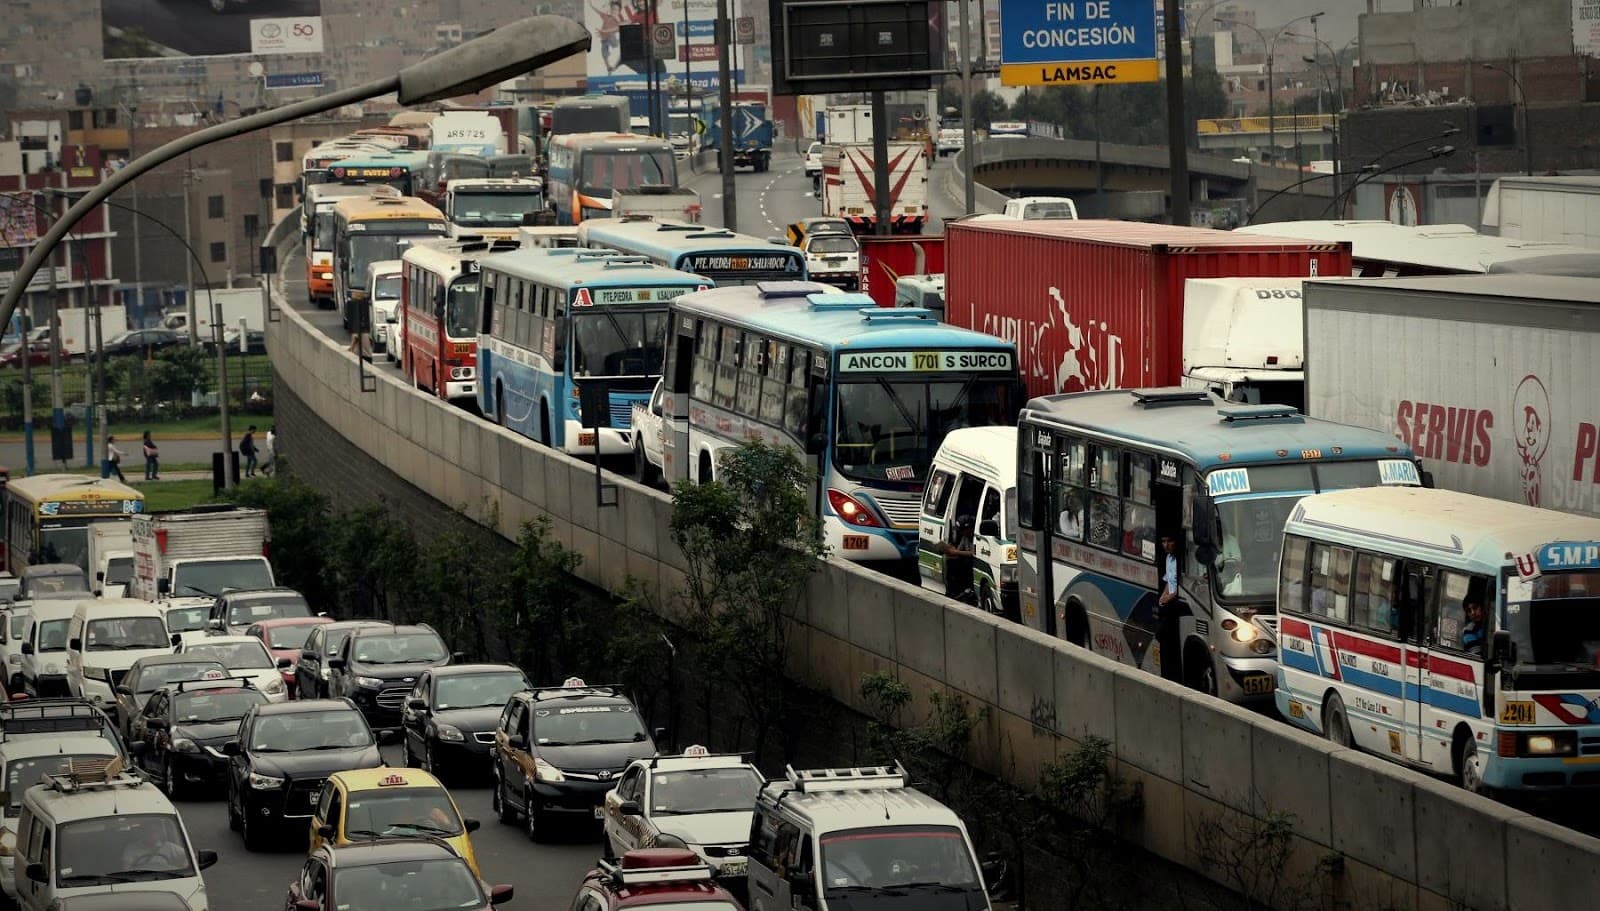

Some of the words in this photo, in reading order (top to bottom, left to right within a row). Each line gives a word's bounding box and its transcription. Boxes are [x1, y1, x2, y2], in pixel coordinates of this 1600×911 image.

[1046, 3, 1074, 21] FIN
[1086, 1, 1110, 19] DE
[1022, 22, 1135, 48] CONCESIÓN
[1042, 65, 1117, 82] LAMSAC
[847, 356, 907, 370] ANCON
[914, 354, 939, 370] 1701
[946, 356, 956, 369] S
[959, 355, 1007, 369] SURCO
[1397, 399, 1494, 468] SERVIS
[1209, 471, 1248, 494] ANCON
[844, 536, 869, 549] 1701
[1244, 677, 1273, 694] 1517
